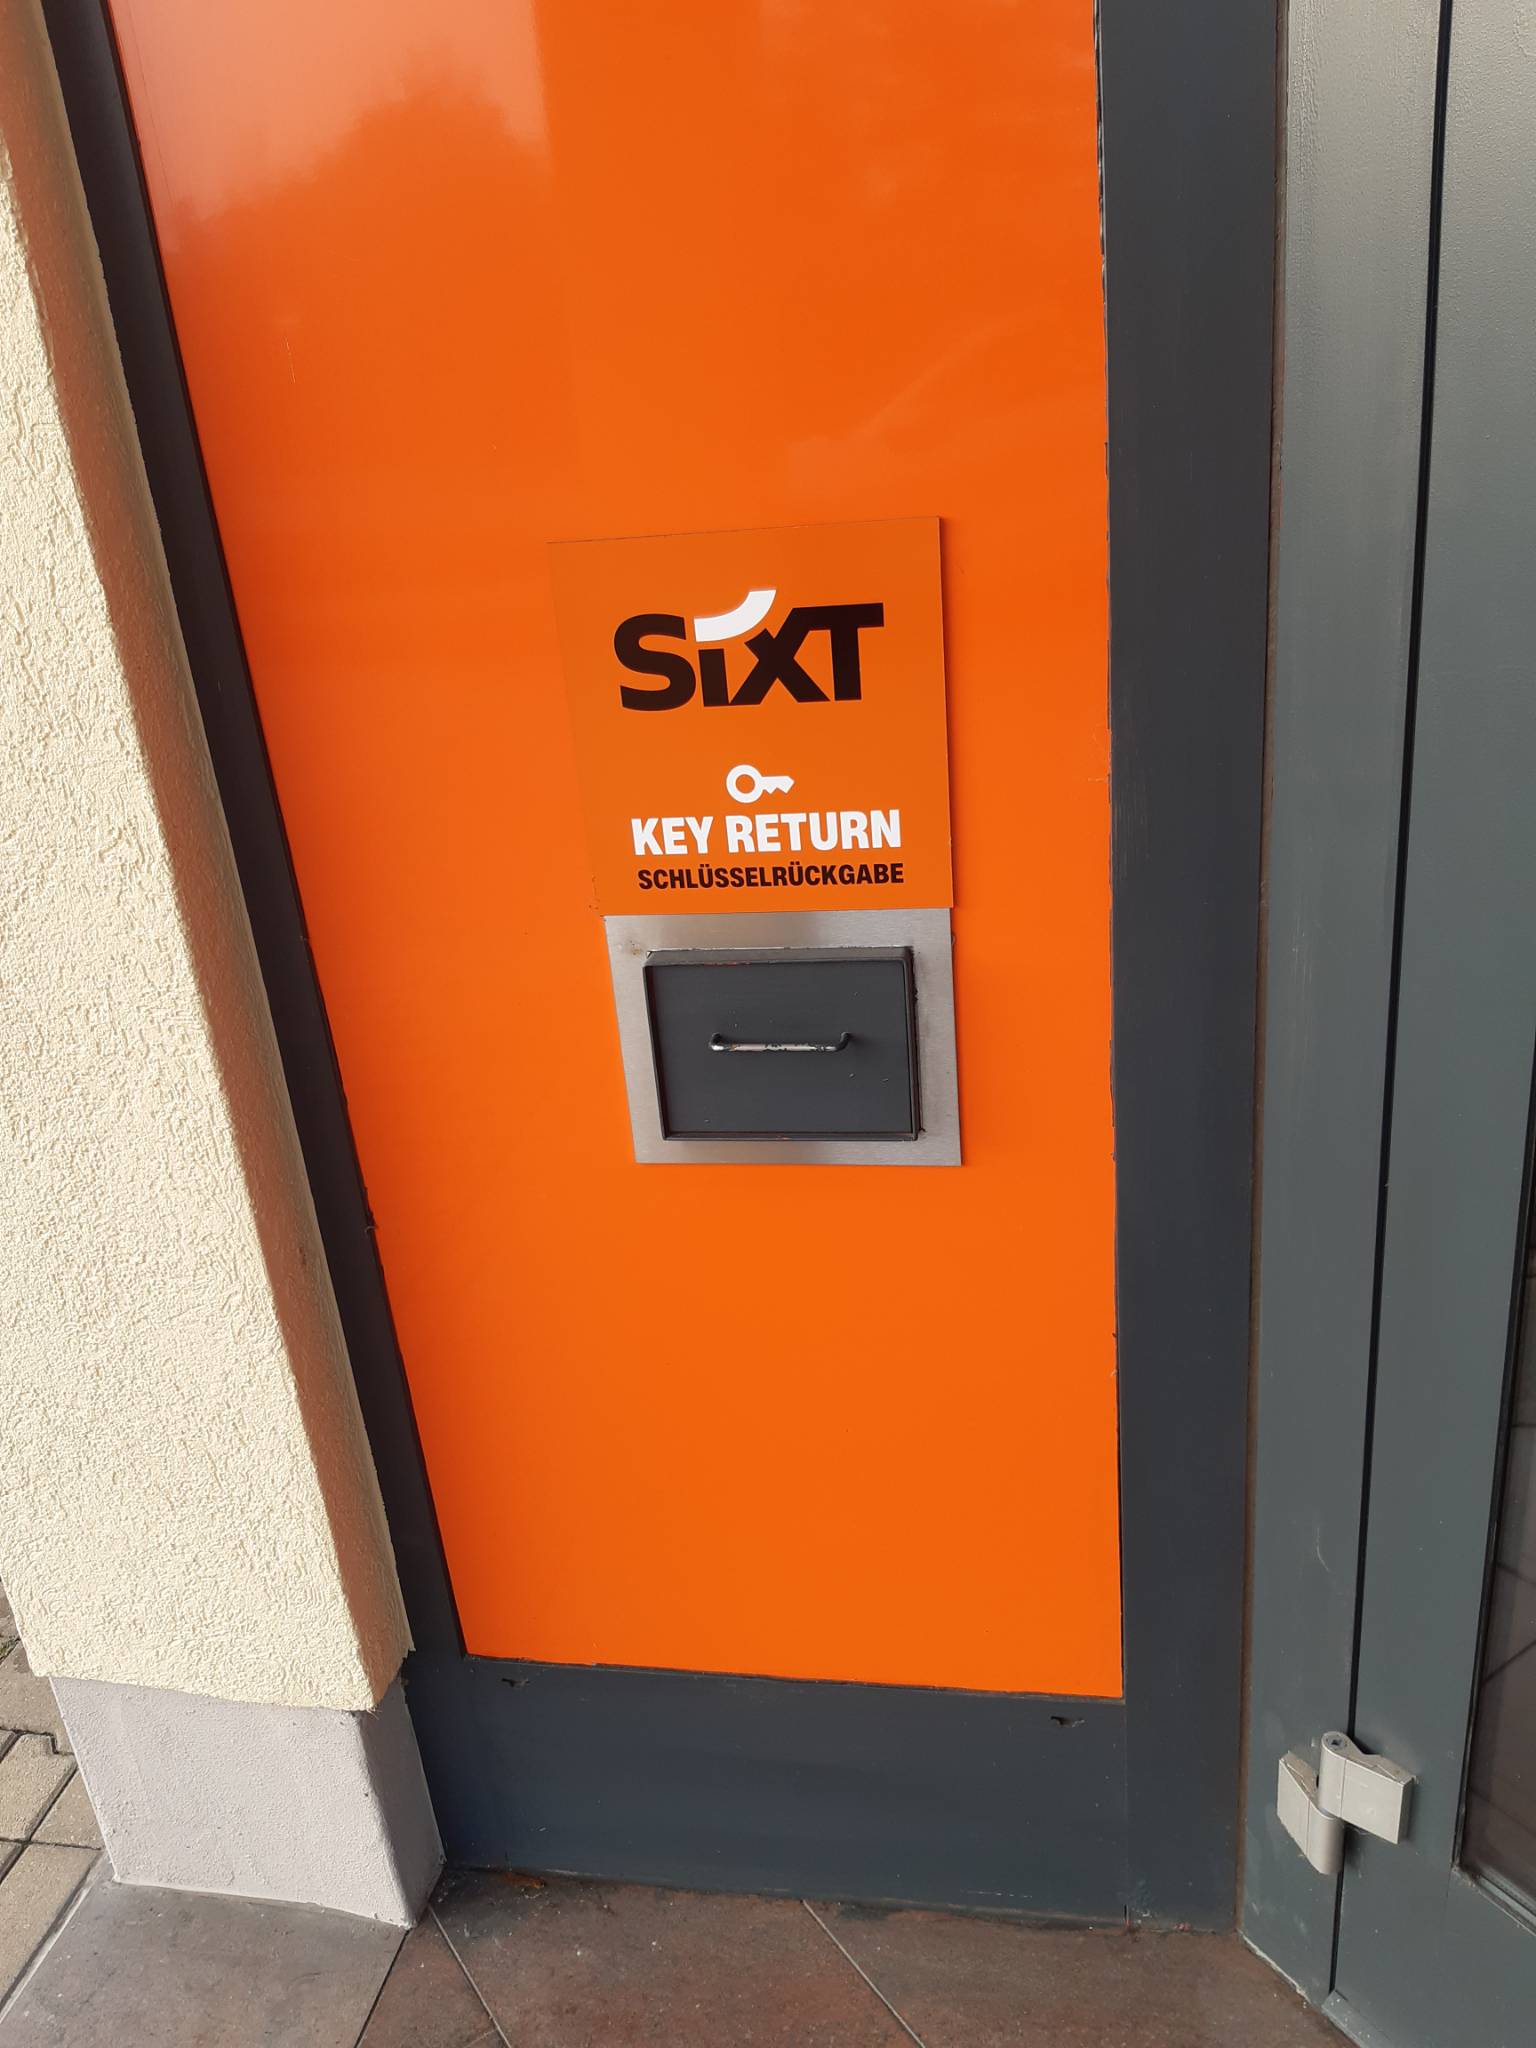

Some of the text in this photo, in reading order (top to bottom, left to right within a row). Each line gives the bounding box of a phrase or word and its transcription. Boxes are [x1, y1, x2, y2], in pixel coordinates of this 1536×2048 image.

[632, 810, 901, 855] KEY RETURN
[638, 862, 903, 889] SCHLÜSSELRÜCKGABE
